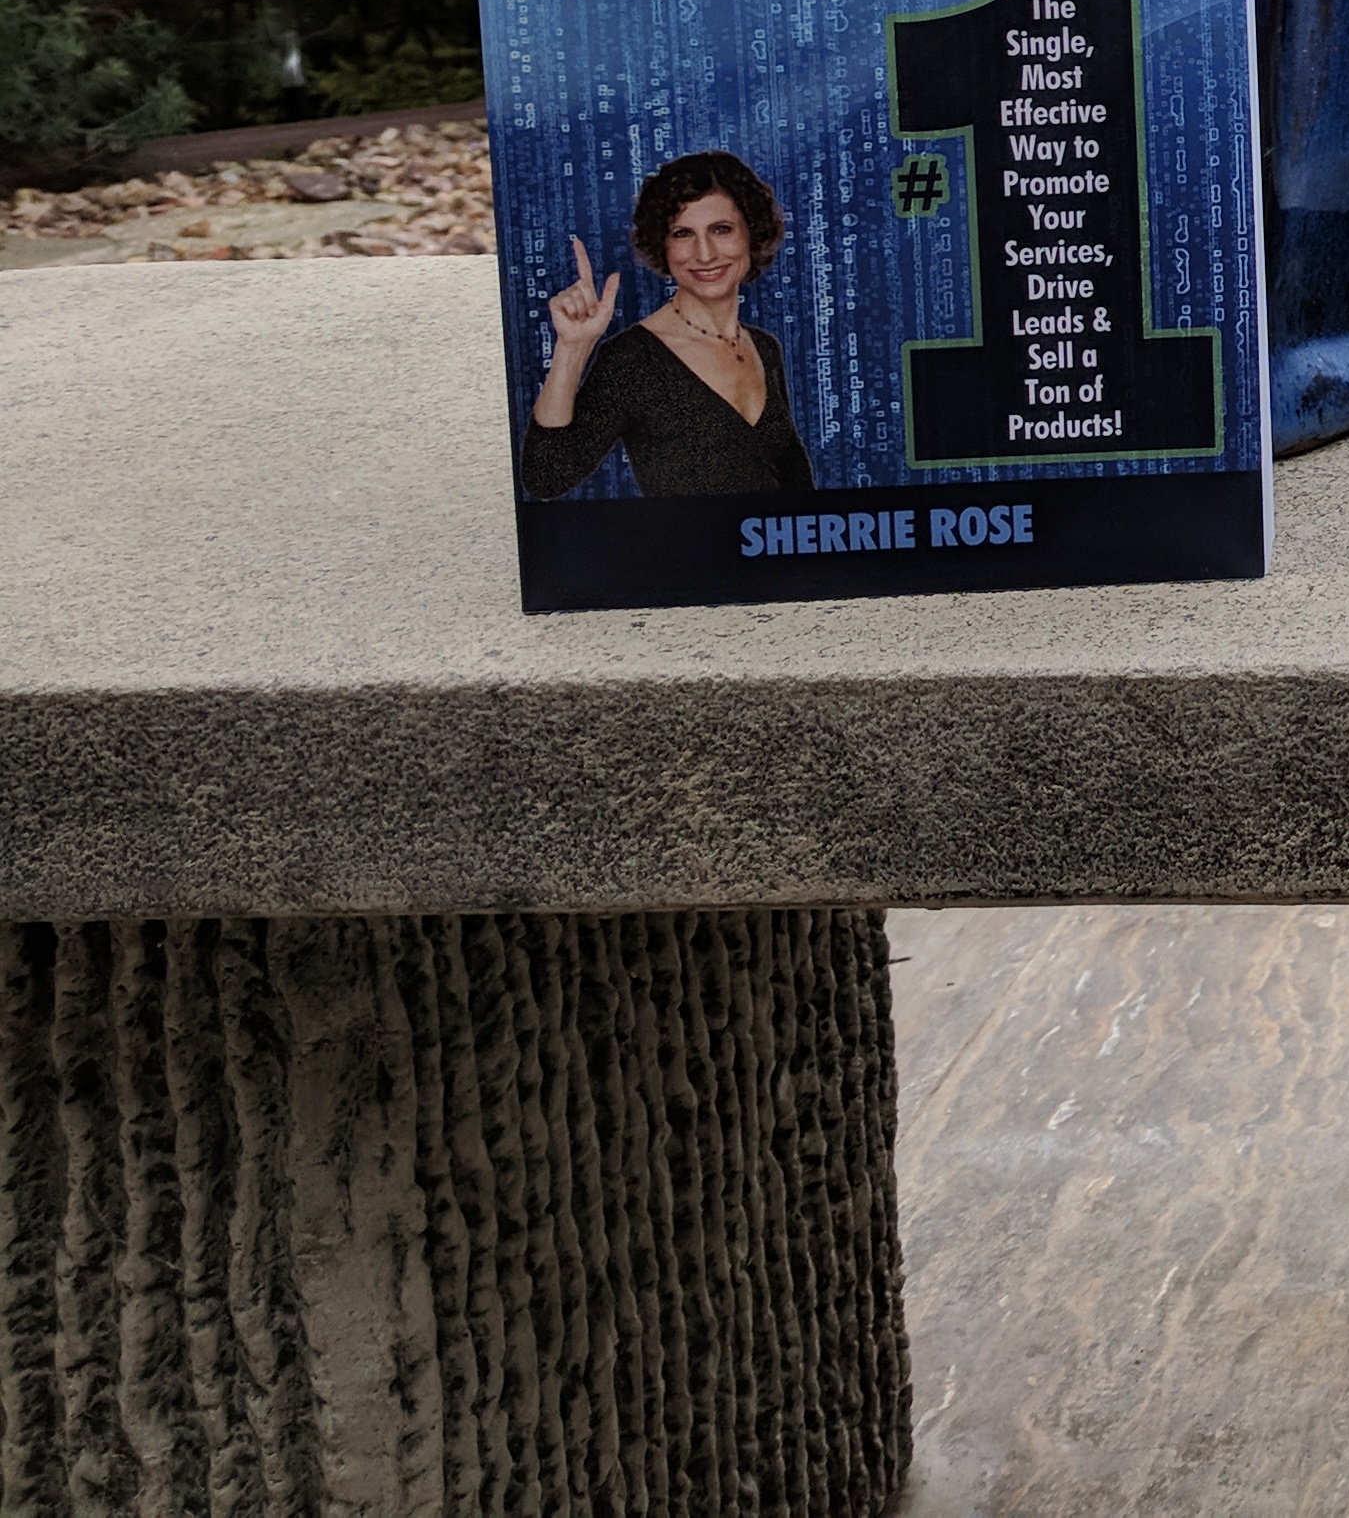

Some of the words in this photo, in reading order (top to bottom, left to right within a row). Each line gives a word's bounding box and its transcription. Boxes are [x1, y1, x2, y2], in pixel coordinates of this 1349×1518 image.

[1006, 26, 1094, 62] Single,
[1021, 63, 1083, 91] Most
[1000, 97, 1107, 127] Effective
[1009, 134, 1069, 166] Way
[1073, 134, 1099, 160] to
[1003, 170, 1110, 197] Promote
[1028, 204, 1086, 230] Your
[1004, 239, 1113, 267] Services,
[1028, 274, 1094, 300] Drive
[1012, 309, 1085, 336] Leads
[1093, 306, 1112, 333] &
[1028, 343, 1074, 370] Sell
[1024, 376, 1070, 405] Ton
[1078, 374, 1104, 401] of
[1008, 410, 1123, 441] Products!
[740, 510, 916, 557] SHERRIE
[931, 504, 1034, 547] ROSE
